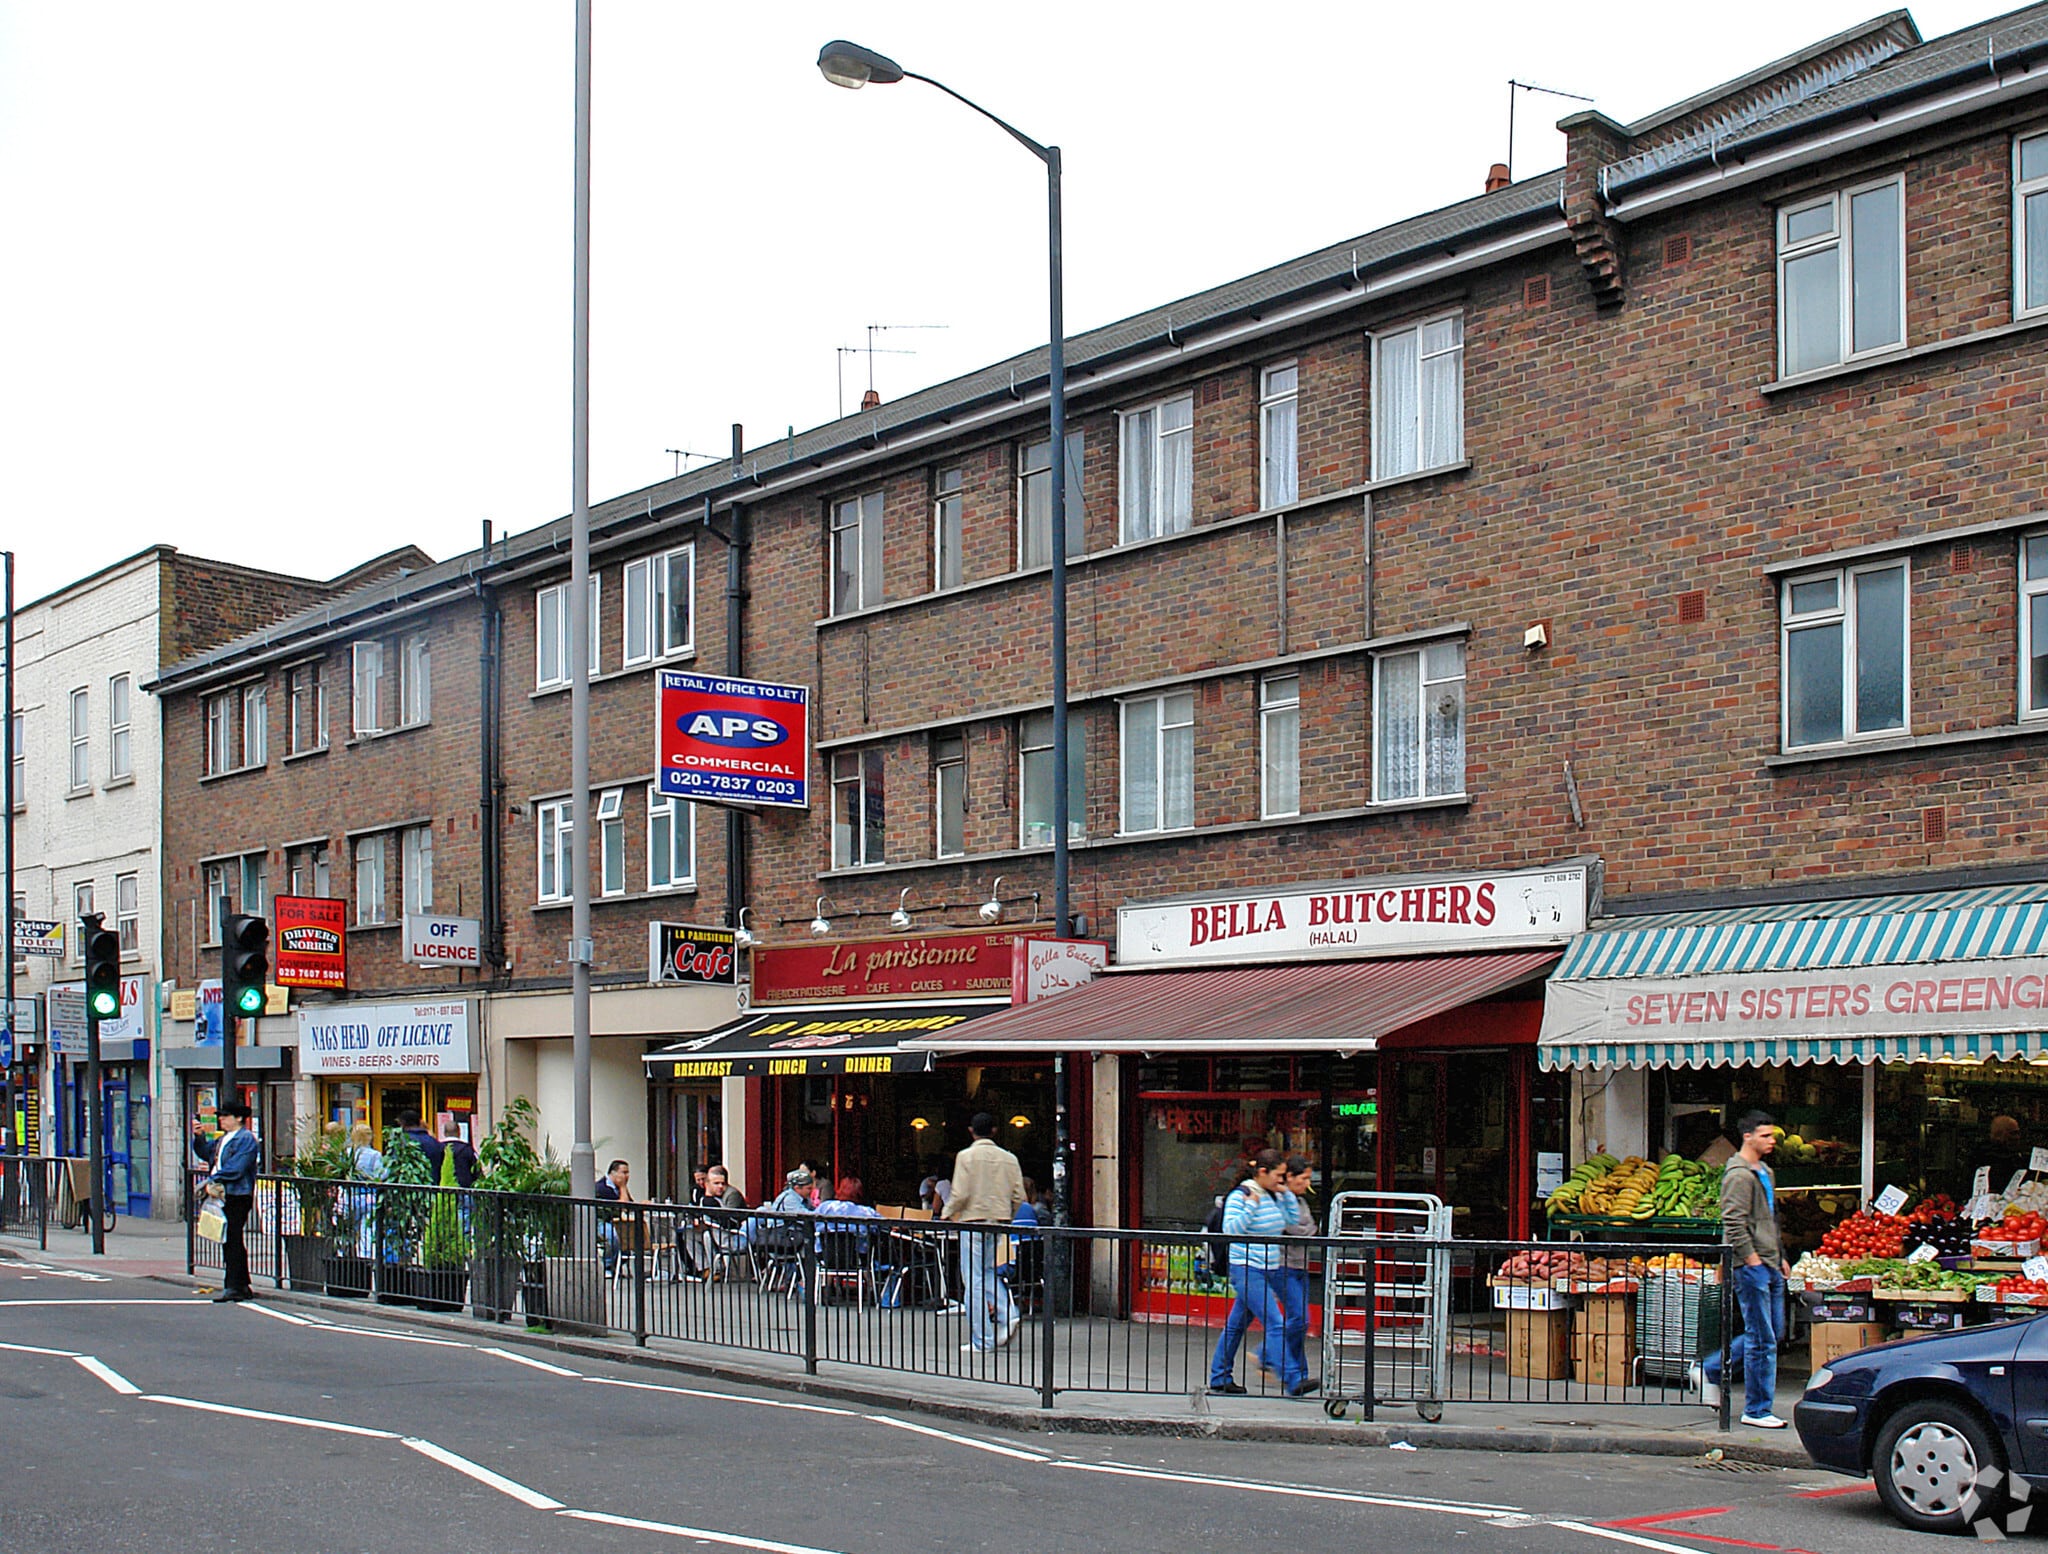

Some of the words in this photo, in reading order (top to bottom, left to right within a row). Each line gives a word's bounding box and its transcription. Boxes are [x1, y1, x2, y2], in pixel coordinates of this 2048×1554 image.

[666, 675, 706, 690] RETAIL
[715, 682, 756, 695] OFFICE
[757, 687, 775, 697] TO
[777, 689, 798, 700] LET
[687, 714, 779, 742] APS
[671, 754, 795, 775] COMMERCIAL
[756, 780, 795, 795] 0203
[280, 907, 304, 919] FOR
[309, 910, 341, 922] SALE
[1190, 900, 1286, 947] BELLA
[1308, 882, 1496, 927] BUTCHERS
[284, 929, 338, 943] DRIVERS
[430, 923, 458, 938] OFF
[675, 929, 685, 939] LA
[688, 930, 733, 944] PARISIENNE
[1309, 929, 1358, 946] (HALAL)
[21, 938, 33, 946] TO
[36, 939, 55, 947] LET
[288, 940, 334, 952] NORRIS
[413, 943, 477, 961] LICENCE
[823, 944, 857, 977] La
[864, 940, 978, 981] parisienne
[1032, 948, 1060, 972] Bella
[279, 959, 342, 971] COMMERCIAL
[675, 942, 733, 980] Café
[279, 968, 295, 977] 020
[866, 983, 890, 994] CAFE
[911, 979, 943, 992] CAKES
[1626, 990, 1729, 1026] SEVEN
[1738, 983, 1871, 1021] SISTERS
[312, 1025, 338, 1051] NAGS
[341, 1024, 369, 1050] HEAD
[377, 1025, 400, 1048] OFF
[402, 1023, 453, 1047] LICENCE
[321, 1056, 350, 1068] WINES
[358, 1055, 393, 1067] BEERS
[400, 1054, 440, 1067] SPIRITS
[674, 1061, 734, 1077] BREAKFAST
[768, 1059, 808, 1075] LUNCH
[845, 1057, 892, 1073] DINNER
[1166, 1106, 1213, 1134] FRESH
